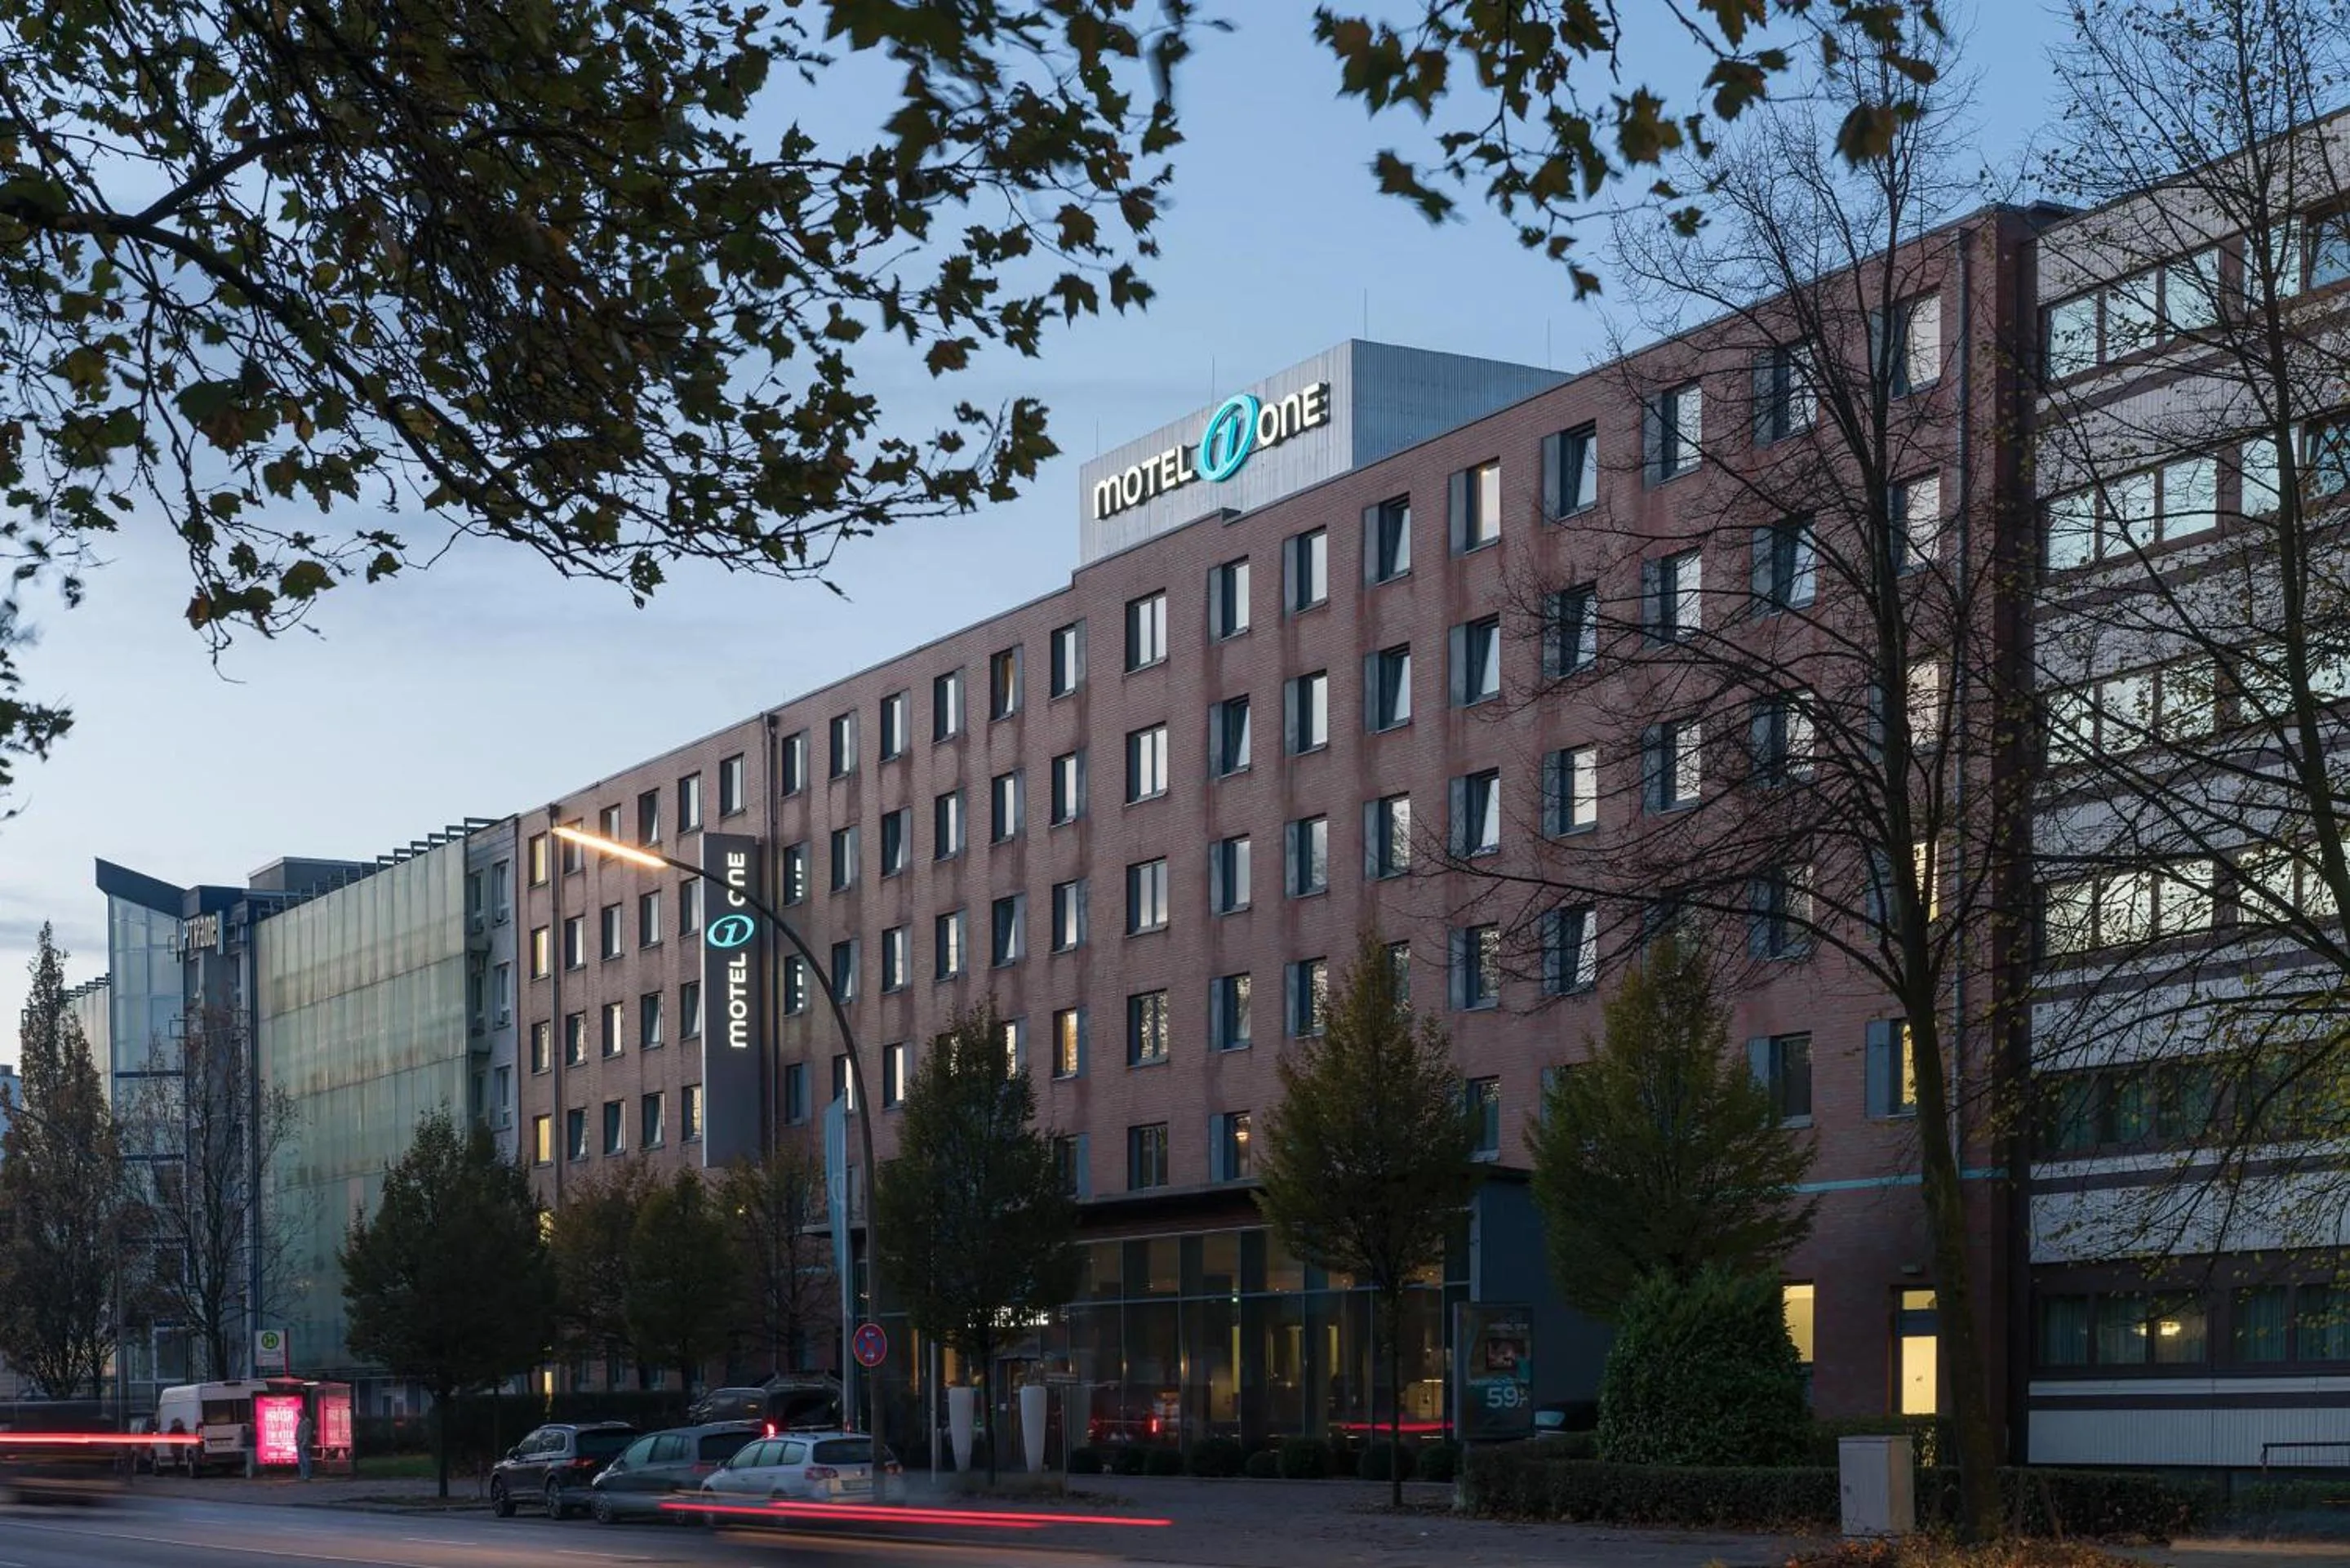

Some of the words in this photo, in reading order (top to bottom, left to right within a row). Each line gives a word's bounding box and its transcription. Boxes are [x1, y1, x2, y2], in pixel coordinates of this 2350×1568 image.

[1093, 445, 1194, 519] MOTEL
[1256, 381, 1327, 448] ONE
[729, 952, 748, 1049] MOTEL
